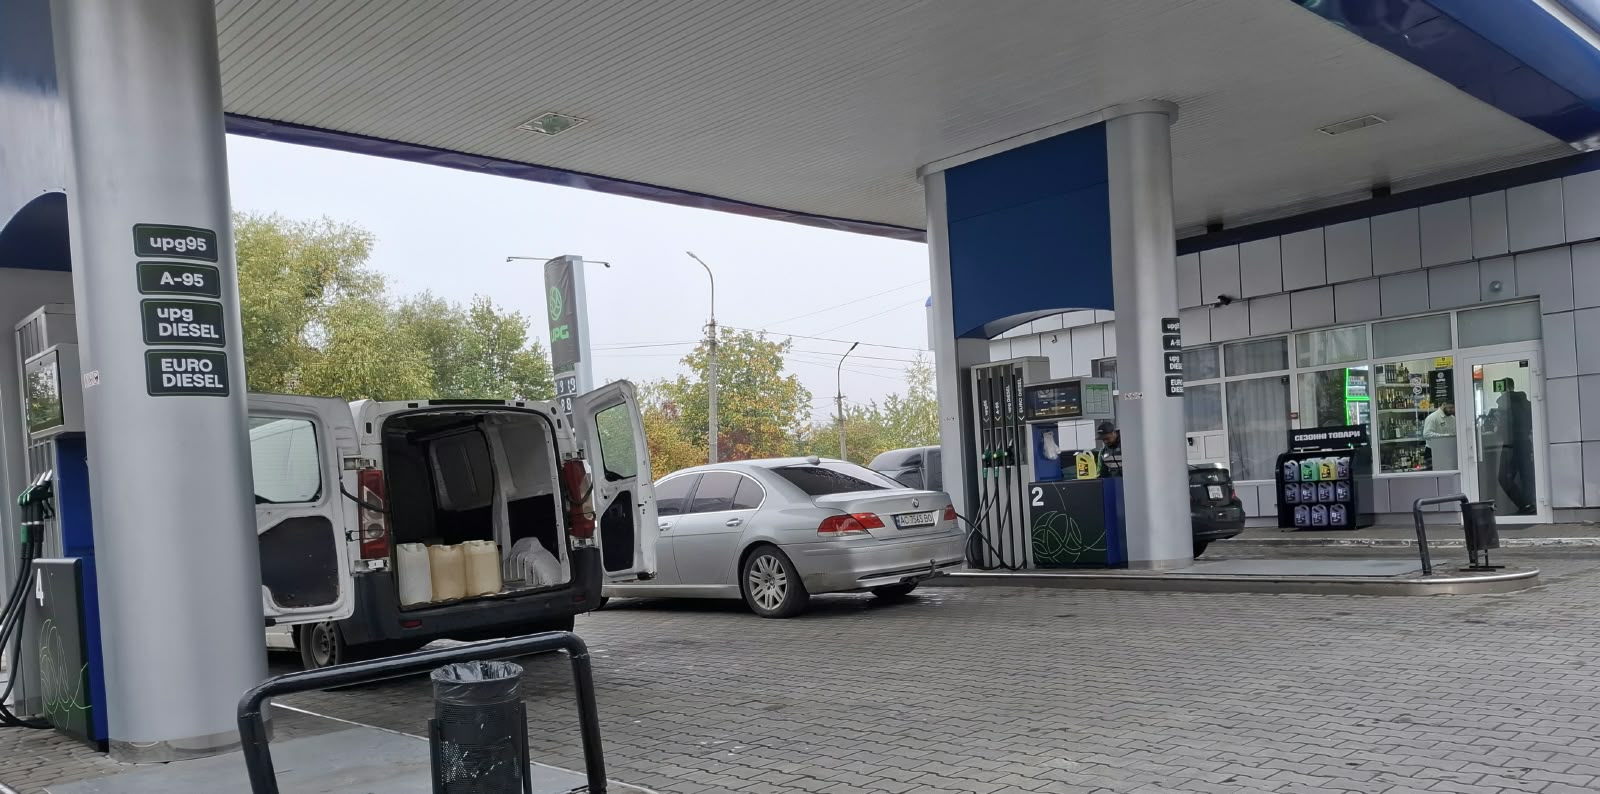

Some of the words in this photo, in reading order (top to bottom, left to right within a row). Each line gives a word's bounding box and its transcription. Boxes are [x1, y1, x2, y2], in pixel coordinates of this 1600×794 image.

[150, 236, 207, 252] upg95
[160, 271, 205, 287] A-95
[157, 307, 194, 322] upg
[158, 322, 219, 339] DIESEL
[161, 358, 212, 372] EURO
[162, 373, 224, 388] DIESEL
[1328, 430, 1361, 439] ТОВАРИ
[1032, 486, 1044, 506] 2
[36, 568, 44, 606] 4
